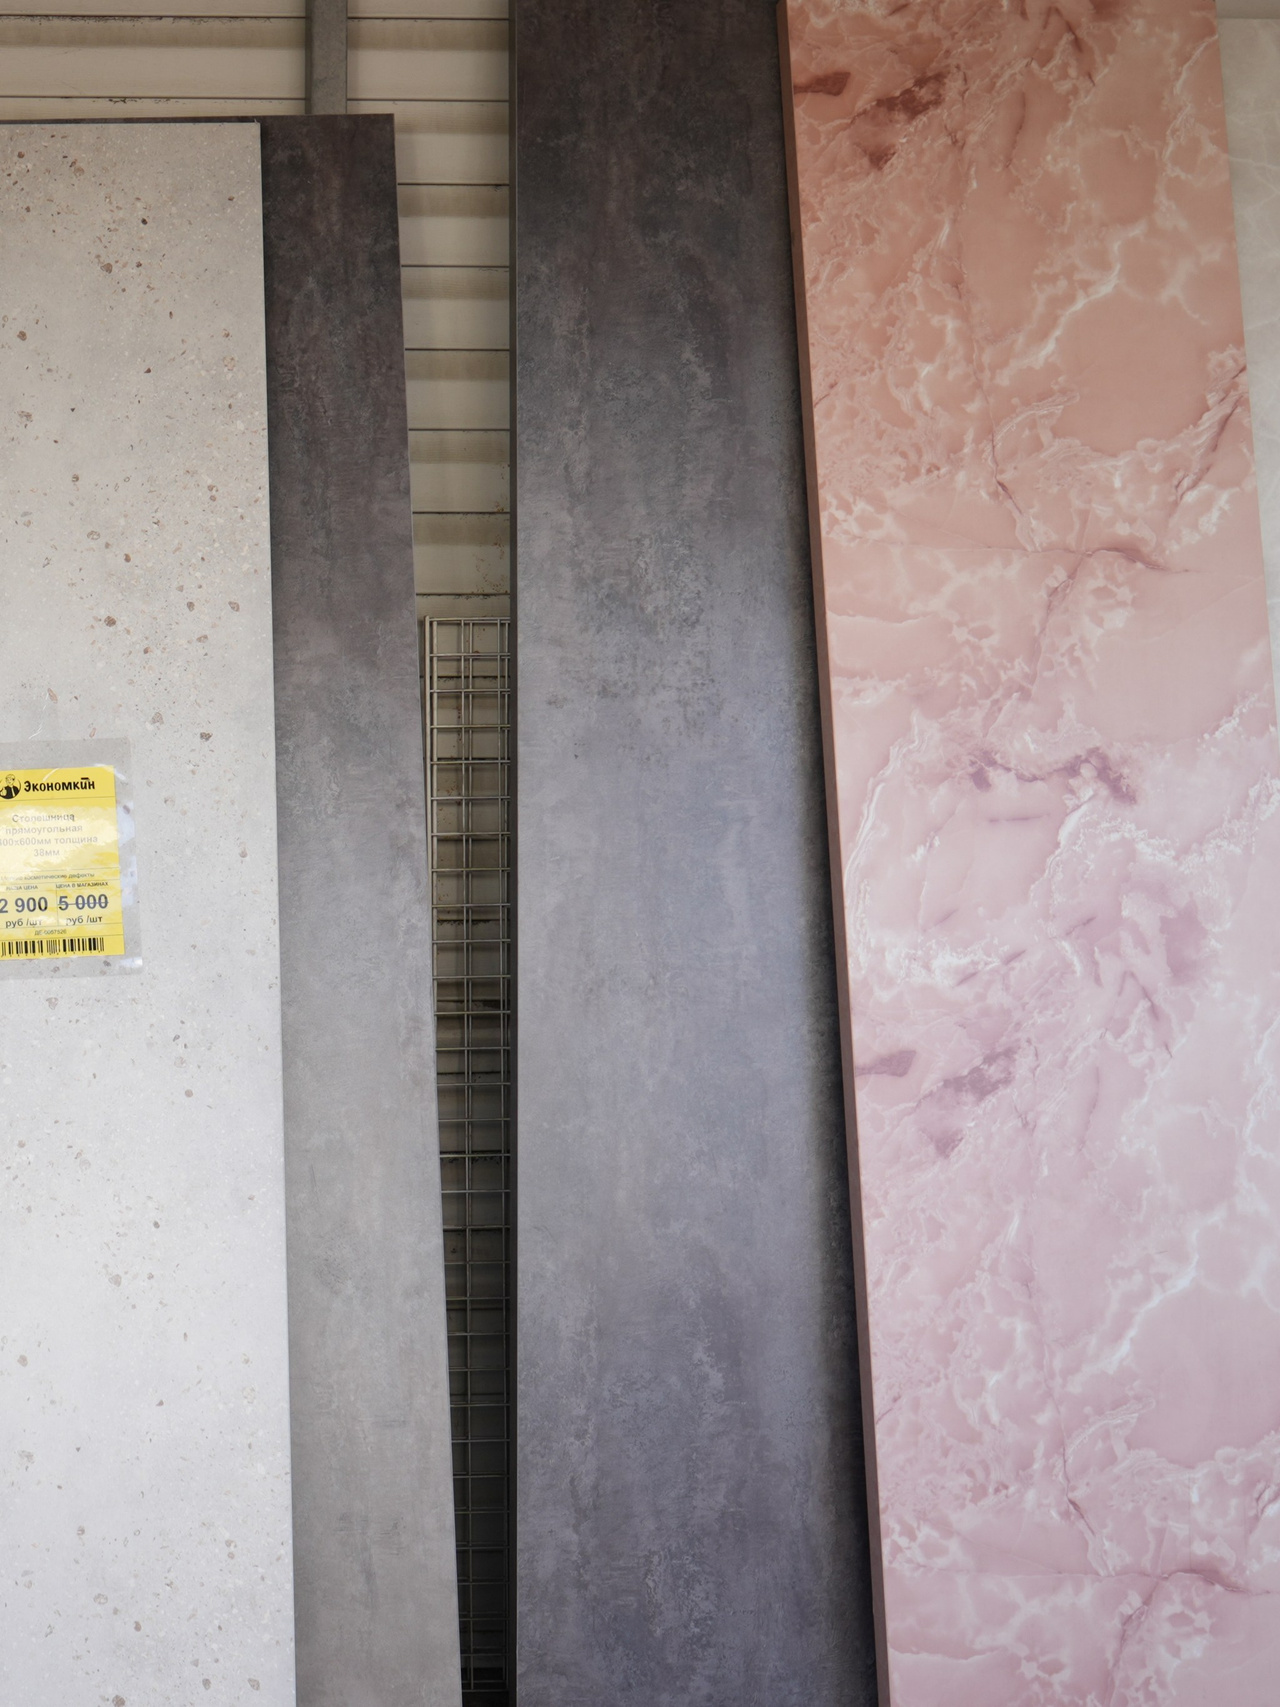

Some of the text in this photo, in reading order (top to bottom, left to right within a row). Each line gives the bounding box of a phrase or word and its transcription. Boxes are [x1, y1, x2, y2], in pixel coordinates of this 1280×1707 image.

[12, 813, 75, 823] Столешница
[5, 825, 83, 836] прямоугольная
[54, 836, 98, 845] толщина
[33, 848, 60, 857] 38мм
[14, 896, 48, 913] 900
[58, 894, 109, 911] 5 000
[5, 918, 43, 928] руб /шт
[65, 915, 103, 926] руб /шт
